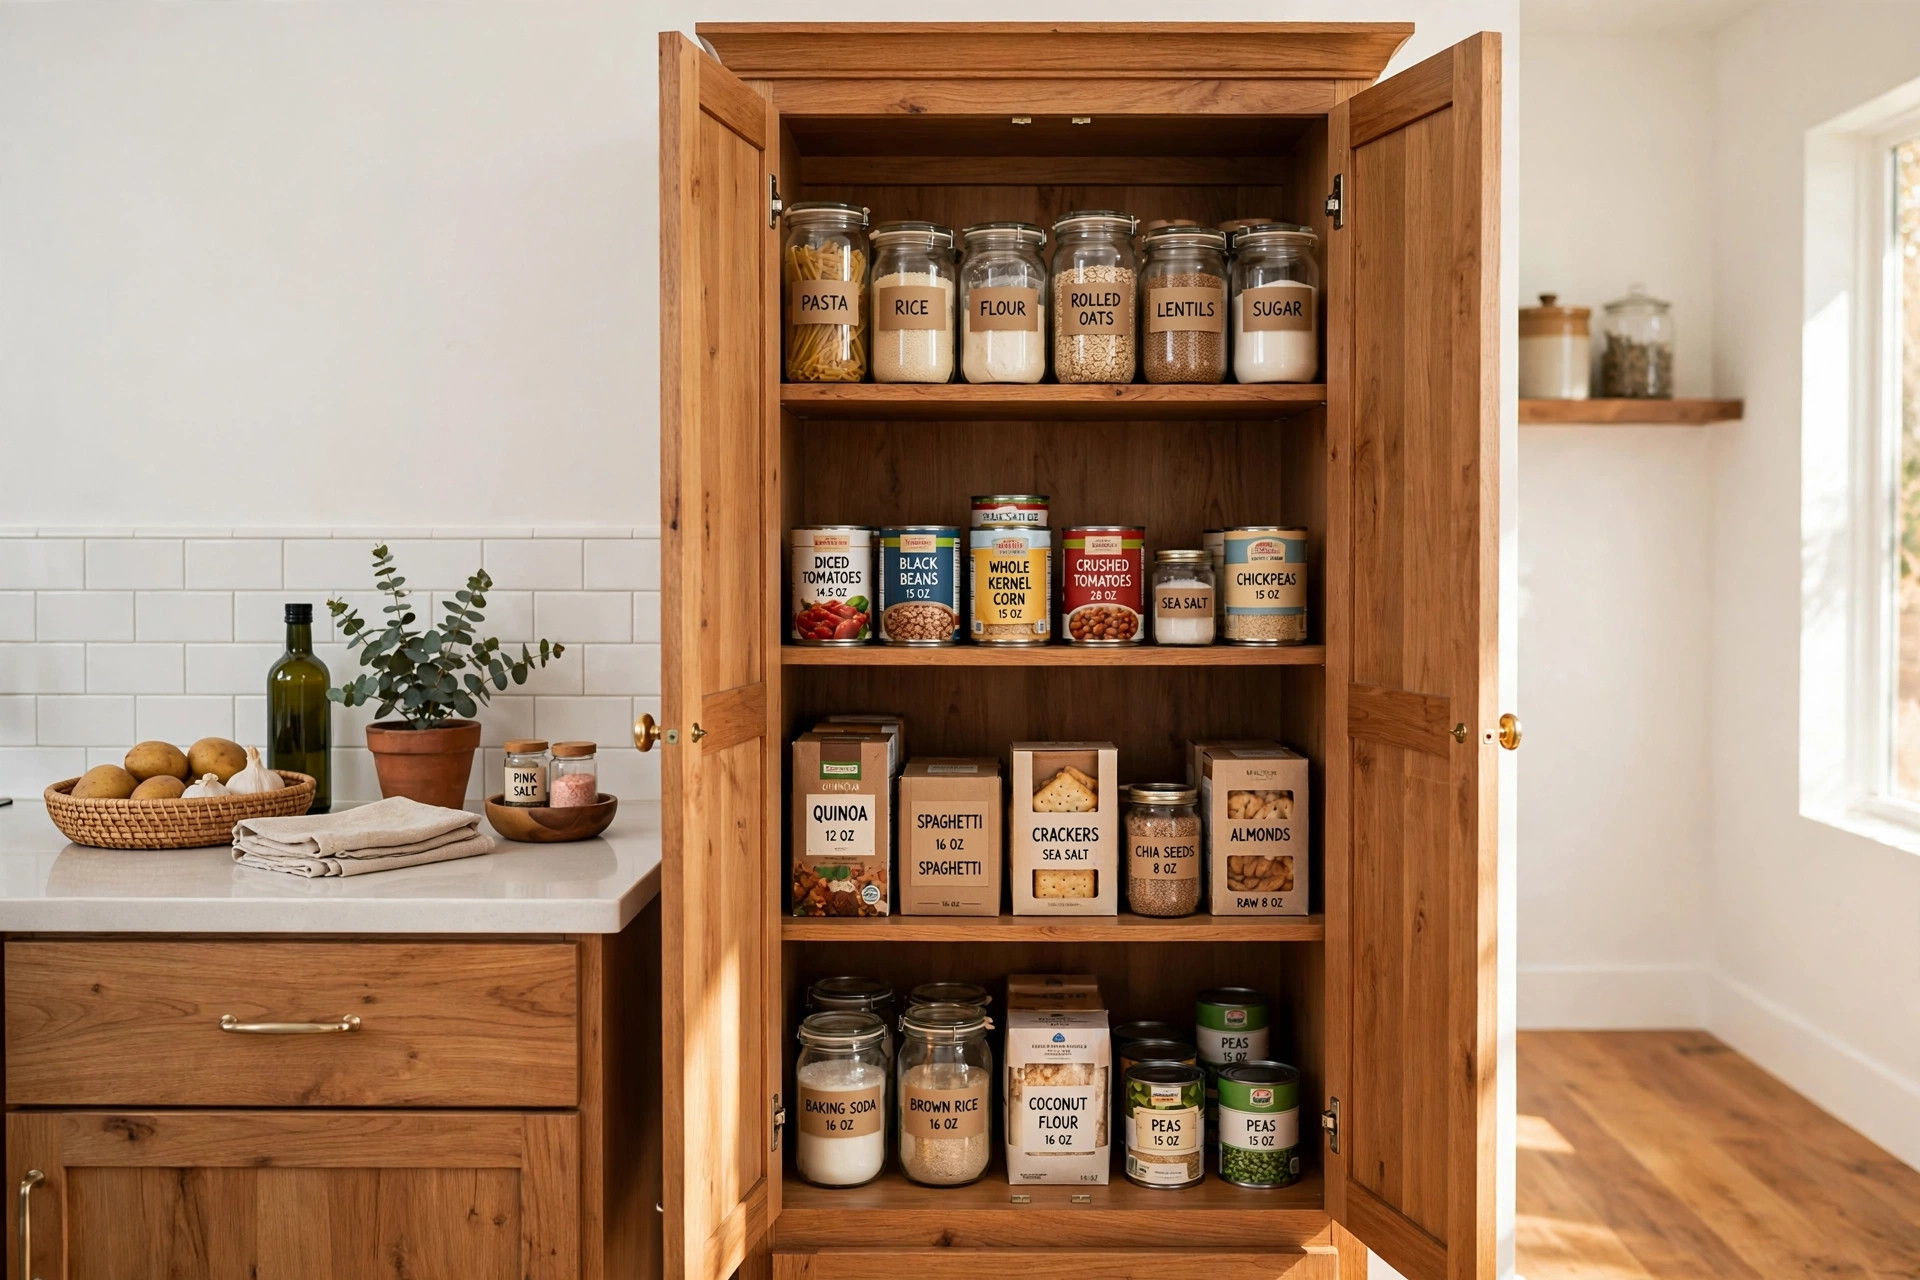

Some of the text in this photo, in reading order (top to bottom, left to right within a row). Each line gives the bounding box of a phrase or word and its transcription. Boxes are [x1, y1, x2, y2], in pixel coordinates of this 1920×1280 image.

[801, 295, 849, 312] PASTA
[896, 299, 928, 315] RICE
[1072, 293, 1120, 308] ROLLED
[981, 301, 1026, 316] FLOUR
[1158, 302, 1214, 317] LENTILS
[1253, 302, 1303, 317] SUGAR
[1080, 311, 1113, 325] OATS
[814, 556, 850, 569] DICED
[900, 557, 938, 570] BLACK
[989, 561, 1029, 574] WHOLE
[1077, 559, 1129, 571] CRUSHED
[803, 571, 862, 585] TOMATOES
[901, 572, 938, 585] BEANS
[989, 577, 1031, 590] KERNEL
[1074, 574, 1131, 587] TOMATOES
[1236, 572, 1297, 586] CHICKPEAS
[816, 588, 846, 597] 14.5 OZ
[906, 589, 930, 598] 15 OZ
[994, 593, 1024, 605] CORN
[1105, 591, 1116, 600] OZ
[1256, 590, 1279, 599] 15 OZ
[1162, 597, 1208, 609] SEA SALT
[999, 609, 1022, 618] 15 OZ
[513, 772, 537, 784] PINK
[513, 785, 538, 797] SALT
[814, 805, 867, 823] QUINOA
[918, 814, 982, 829] SPAGHETTI
[826, 830, 854, 841] 12 OZ
[1033, 827, 1099, 842] CRACKERS
[1231, 828, 1290, 841] ALMONDS
[936, 839, 964, 850] 16 OZ
[1043, 849, 1088, 860] SEA SALT
[1136, 845, 1195, 858] CHIA SEEDS
[919, 861, 981, 875] SPAGHETTI
[1154, 863, 1176, 874] 8 OZ
[1237, 898, 1283, 908] RAW 8 OZ
[1222, 1037, 1249, 1049] PEAS
[1223, 1052, 1248, 1062] 15 OZ
[805, 1099, 876, 1115] BAKING SODA
[910, 1098, 978, 1113] BROWN RICE
[1029, 1097, 1087, 1110] COCONUT
[826, 1120, 853, 1130] 16 OZ
[930, 1118, 958, 1129] 16 OZ
[1039, 1116, 1078, 1129] FLOUR
[1152, 1119, 1181, 1132] PEAS
[1247, 1120, 1276, 1132] PEAS
[1046, 1135, 1072, 1145] 16 OZ
[1154, 1136, 1179, 1146] 15 OZ
[1249, 1136, 1274, 1146] 15 OZ
